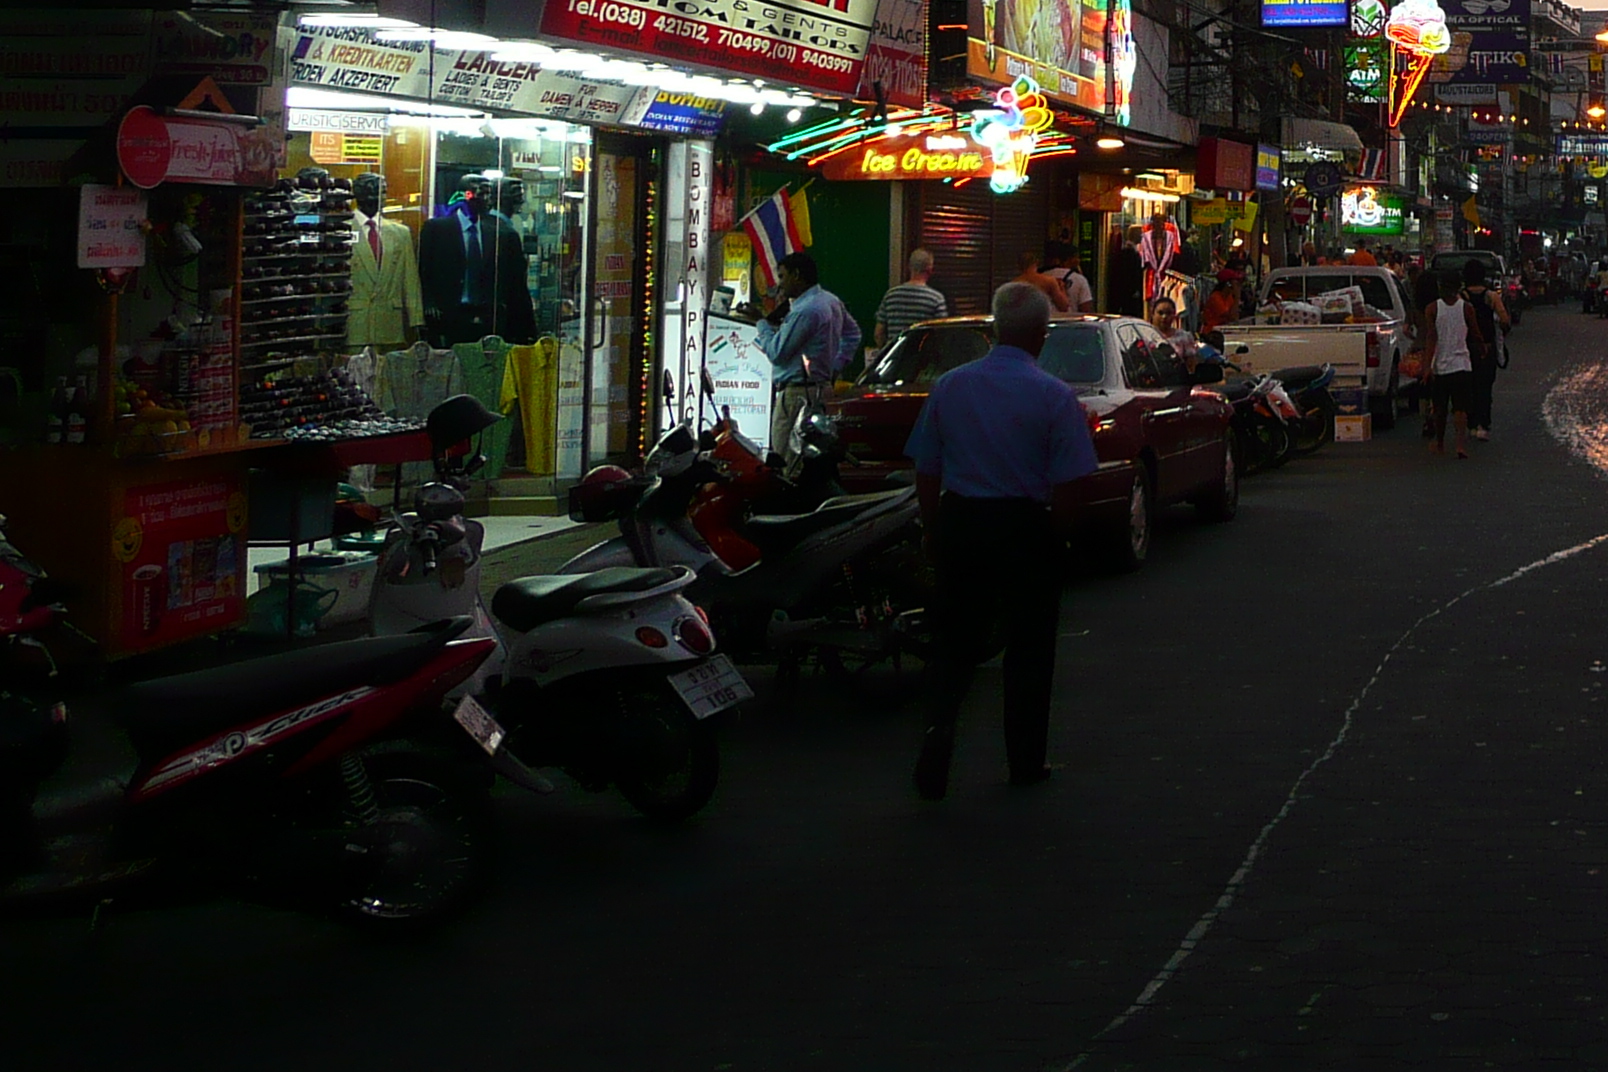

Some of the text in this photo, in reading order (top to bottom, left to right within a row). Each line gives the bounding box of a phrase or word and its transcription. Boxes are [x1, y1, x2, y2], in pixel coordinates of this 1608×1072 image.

[732, 0, 750, 12] &
[762, 8, 850, 38] GENTS
[1468, 15, 1521, 24] OPTICAL
[741, 15, 861, 55] TAILORS
[311, 42, 417, 74] & KREDITKARTEN
[800, 47, 854, 74] 9403991
[327, 66, 401, 93] AKZEPTIERT
[438, 83, 471, 96] CUSTOM
[444, 70, 481, 86] LADIES
[492, 77, 522, 92] GENTS
[341, 114, 387, 129] SERVIC
[319, 133, 336, 145] ITS
[861, 147, 984, 173] Ice Cream
[684, 161, 701, 422] BOMBAY PALAC
[715, 380, 760, 389] INDIAN FOOD
